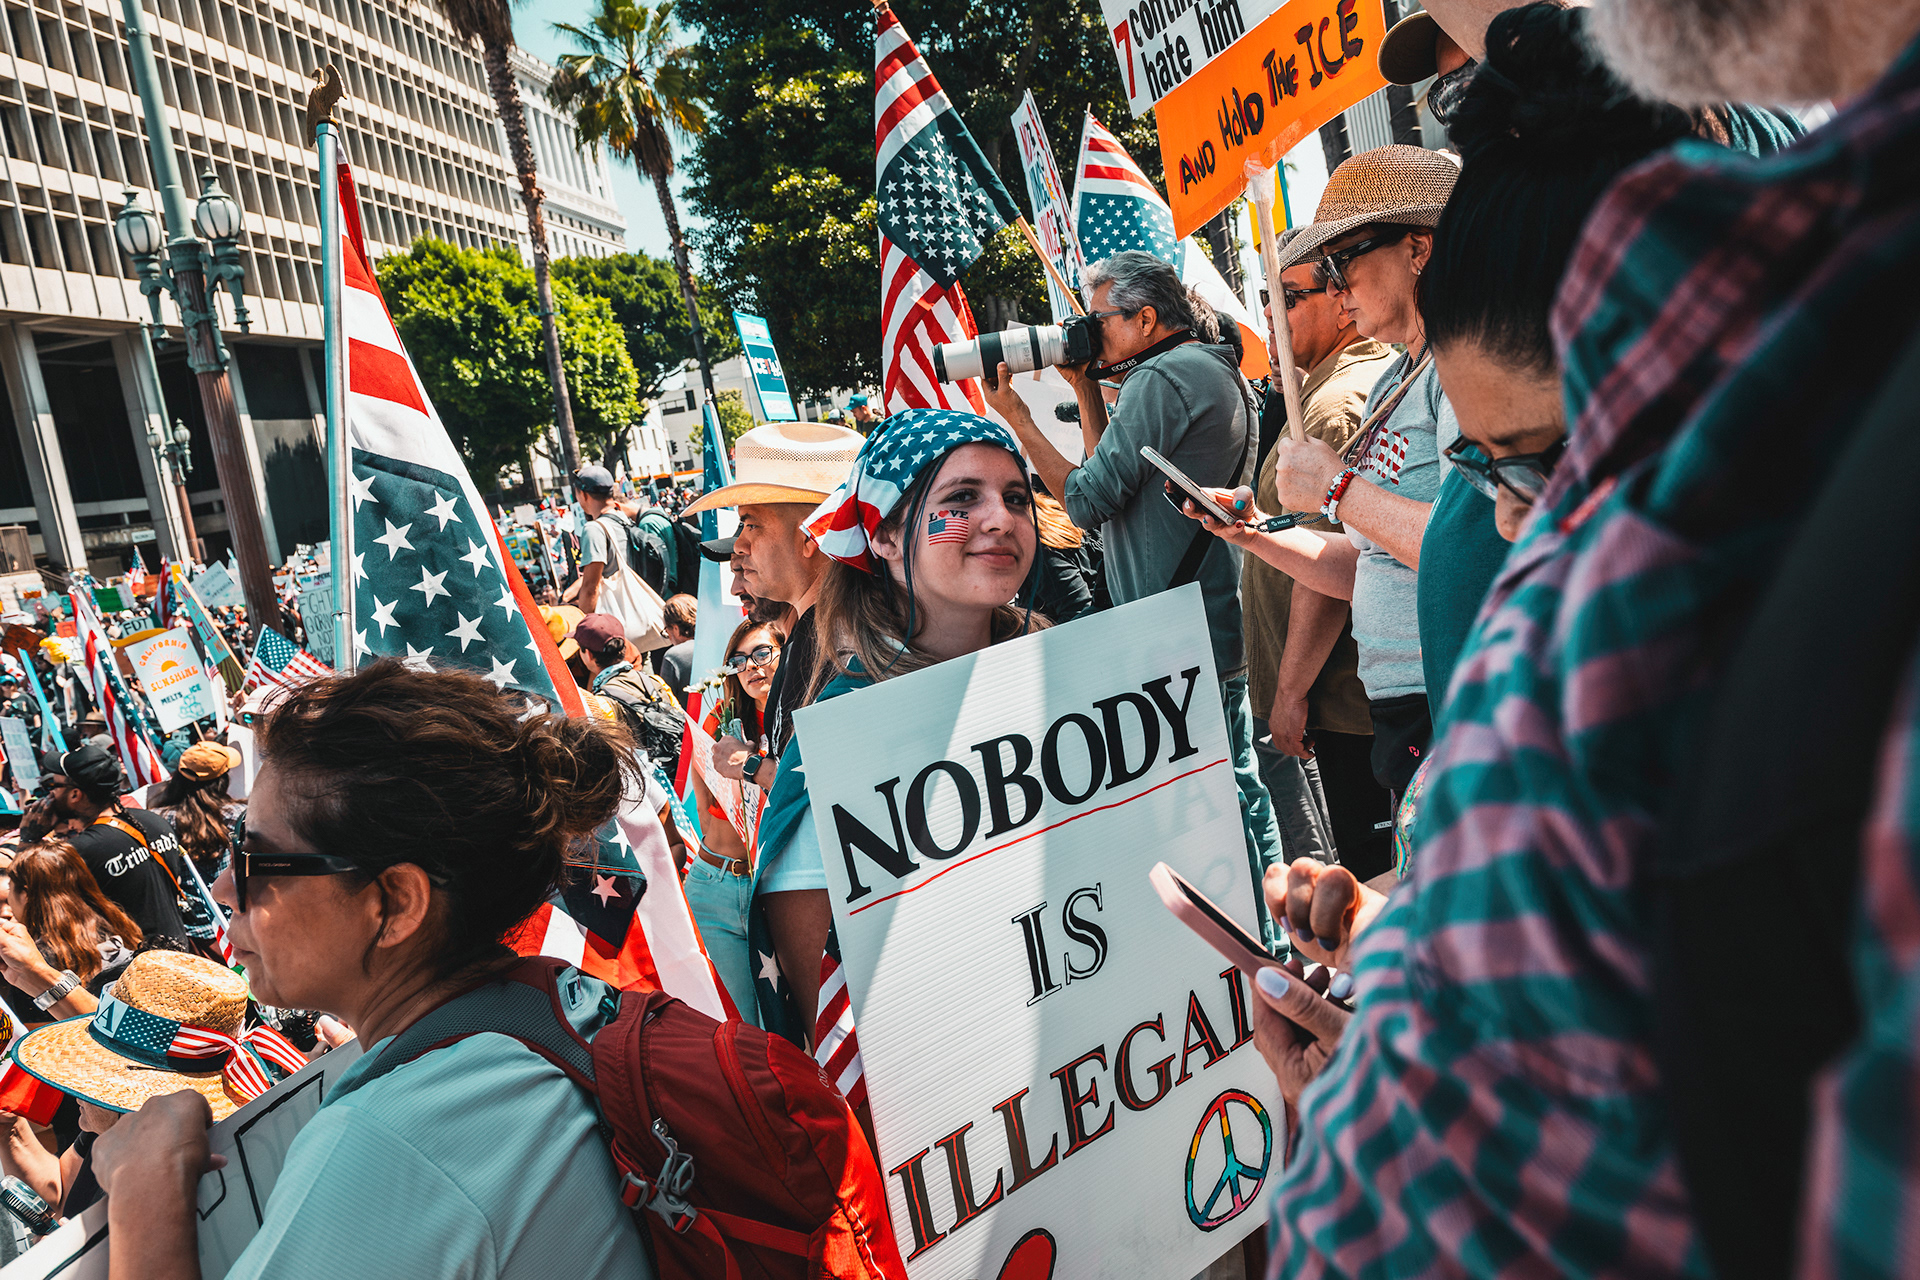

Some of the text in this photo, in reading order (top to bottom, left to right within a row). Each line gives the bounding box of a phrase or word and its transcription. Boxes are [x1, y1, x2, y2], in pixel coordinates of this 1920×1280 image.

[1113, 19, 1136, 100] 7
[1141, 0, 1245, 102] hate him
[1179, 140, 1215, 195] AND
[1261, 48, 1299, 107] THE
[1293, 0, 1363, 90] ICE
[1111, 362, 1128, 372] EOS
[1277, 518, 1291, 526] HALO
[123, 619, 148, 635] FDT
[139, 639, 187, 666] CALIFORNIA
[151, 665, 199, 692] SUNSHINE
[160, 683, 202, 705] MELTS ICE
[831, 666, 1200, 904] NOBODY
[1011, 883, 1108, 1007] IS
